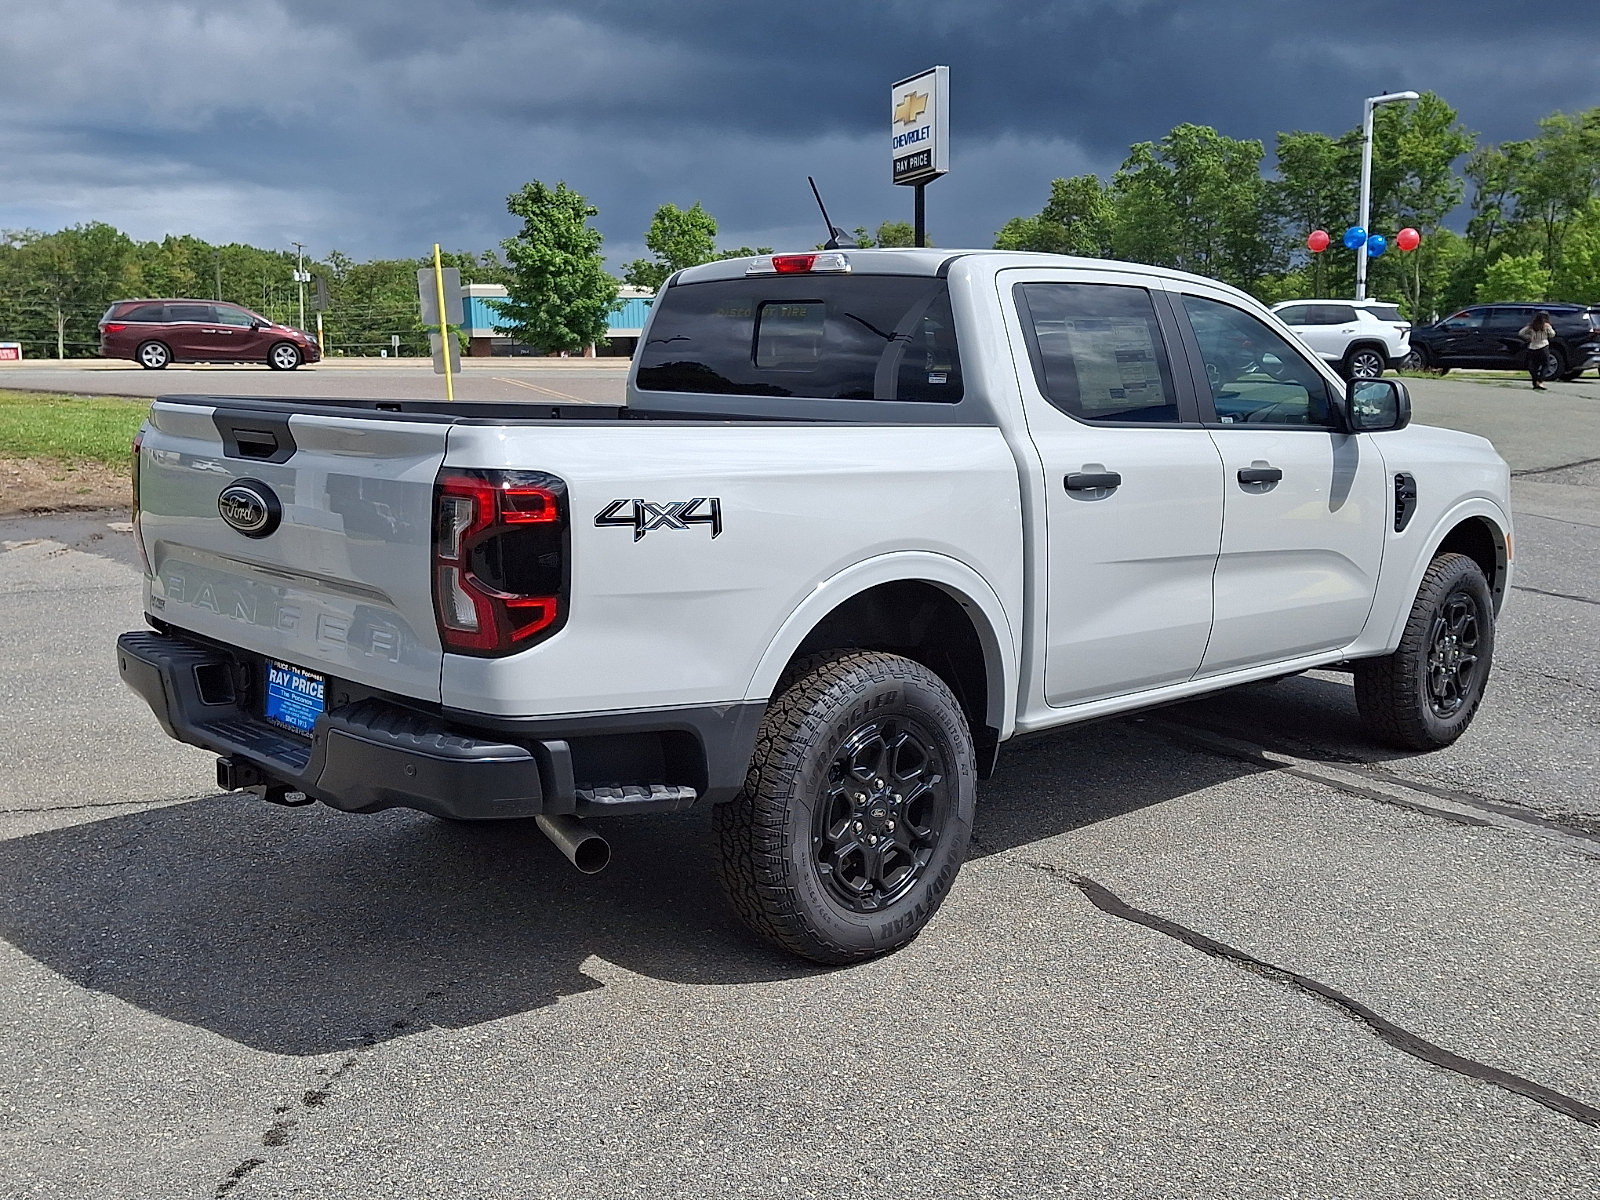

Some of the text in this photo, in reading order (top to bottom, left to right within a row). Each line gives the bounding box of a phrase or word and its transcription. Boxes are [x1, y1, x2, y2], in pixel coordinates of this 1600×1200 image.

[892, 125, 931, 150] CHEVROLET
[896, 153, 928, 172] RAY PRICE
[226, 495, 253, 521] Ford
[167, 576, 400, 665] RANGER
[269, 668, 324, 699] RAY PRICE
[280, 689, 290, 698] The
